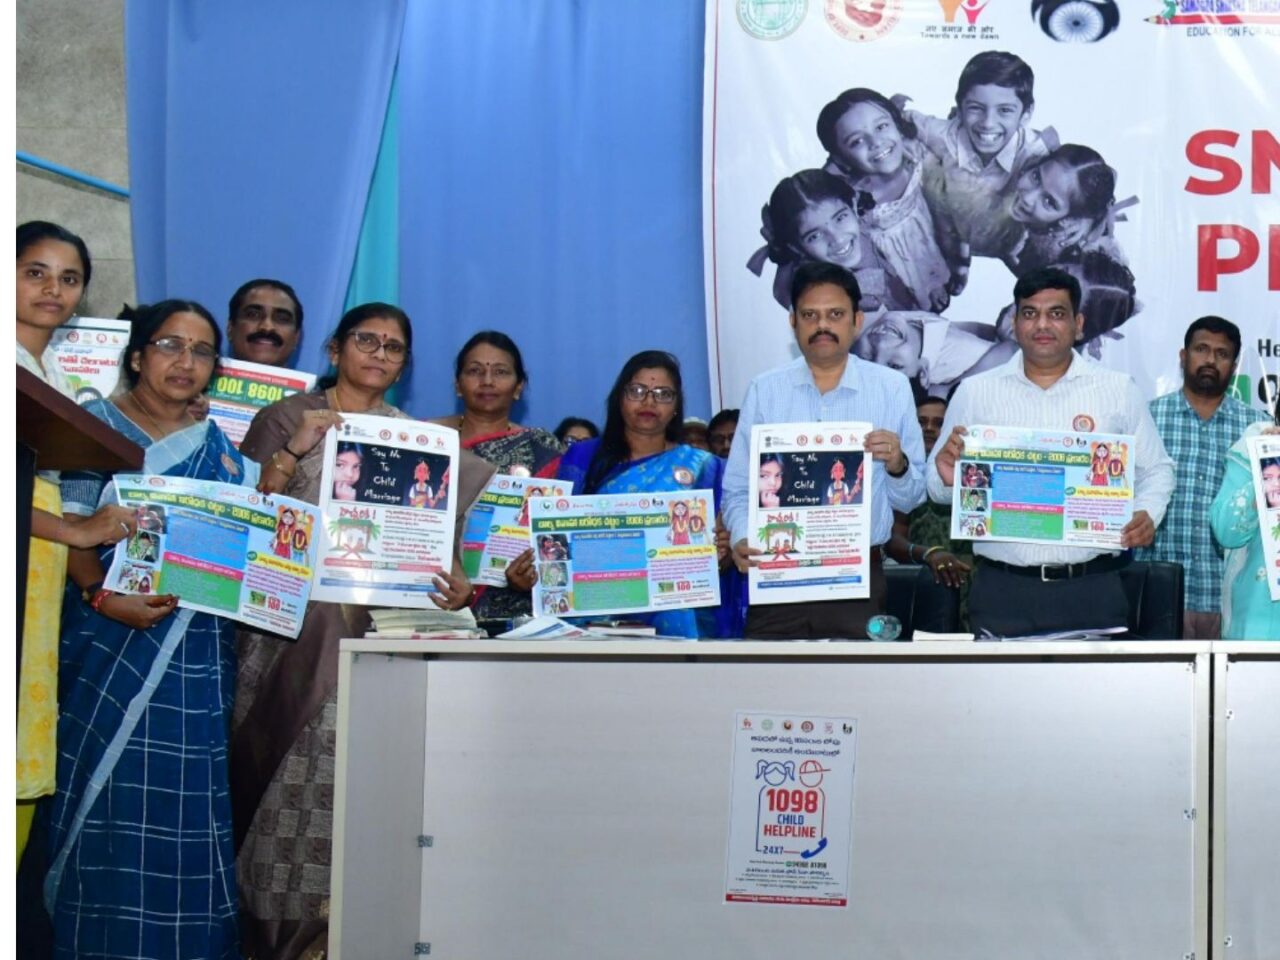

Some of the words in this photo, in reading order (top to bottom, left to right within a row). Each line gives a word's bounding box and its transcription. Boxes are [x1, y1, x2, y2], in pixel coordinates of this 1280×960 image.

[216, 376, 244, 395] 100
[247, 383, 283, 401] 1098
[373, 476, 396, 487] Child
[794, 480, 815, 489] Child
[364, 489, 402, 504] Marriage
[787, 494, 820, 505] Marriage
[766, 788, 818, 814] 1098
[777, 814, 804, 825] CHILD
[763, 825, 816, 838] HELPLINE
[762, 845, 784, 855] 24X7
